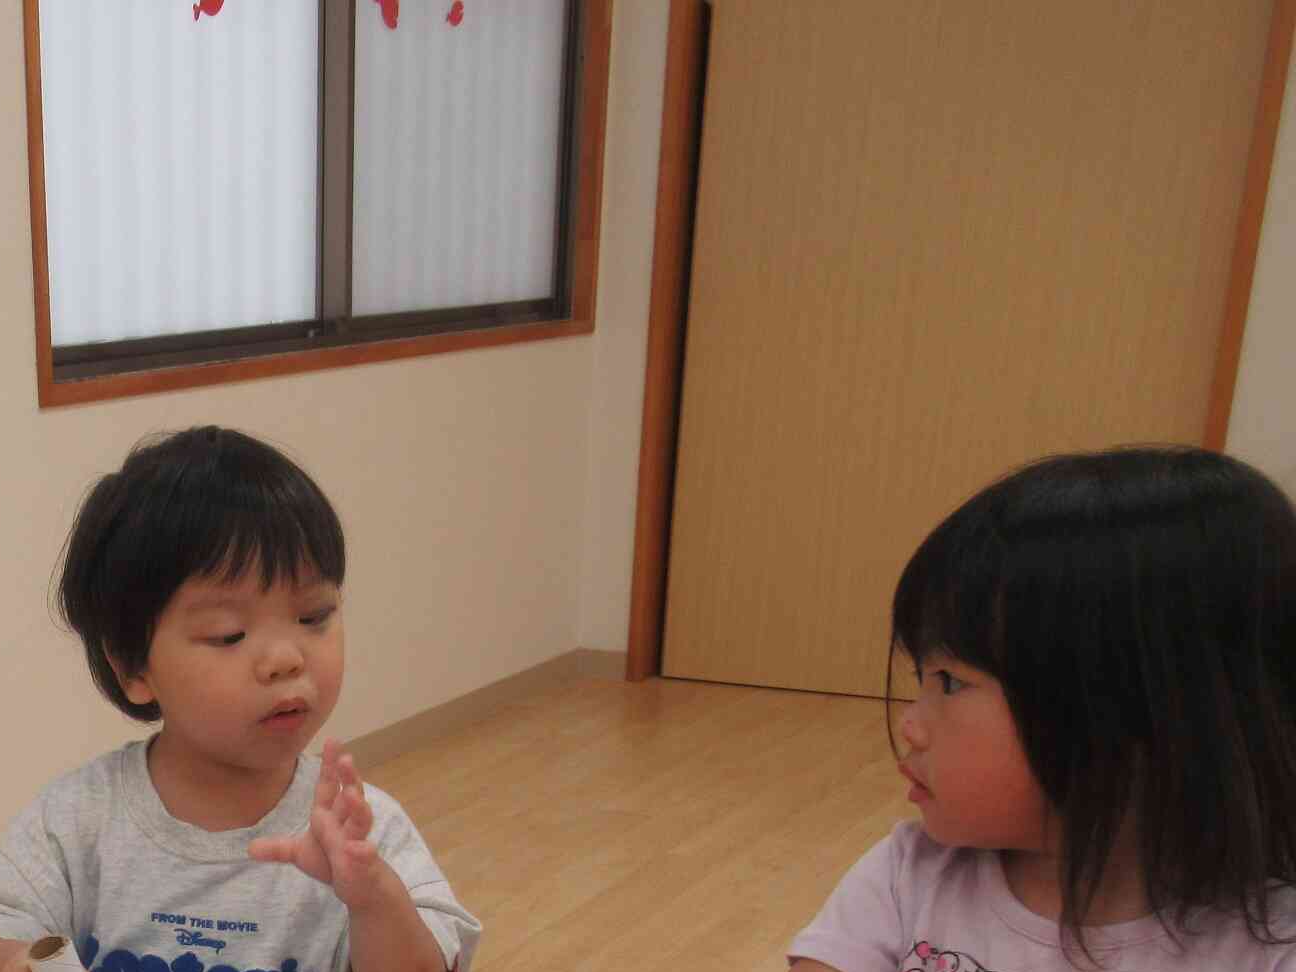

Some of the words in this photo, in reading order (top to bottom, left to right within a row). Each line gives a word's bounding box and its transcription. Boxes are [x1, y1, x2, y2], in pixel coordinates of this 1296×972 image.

[150, 911, 186, 925] FROM
[189, 917, 215, 929] THE
[216, 919, 259, 932] MOVIE
[173, 928, 227, 955] Disney
